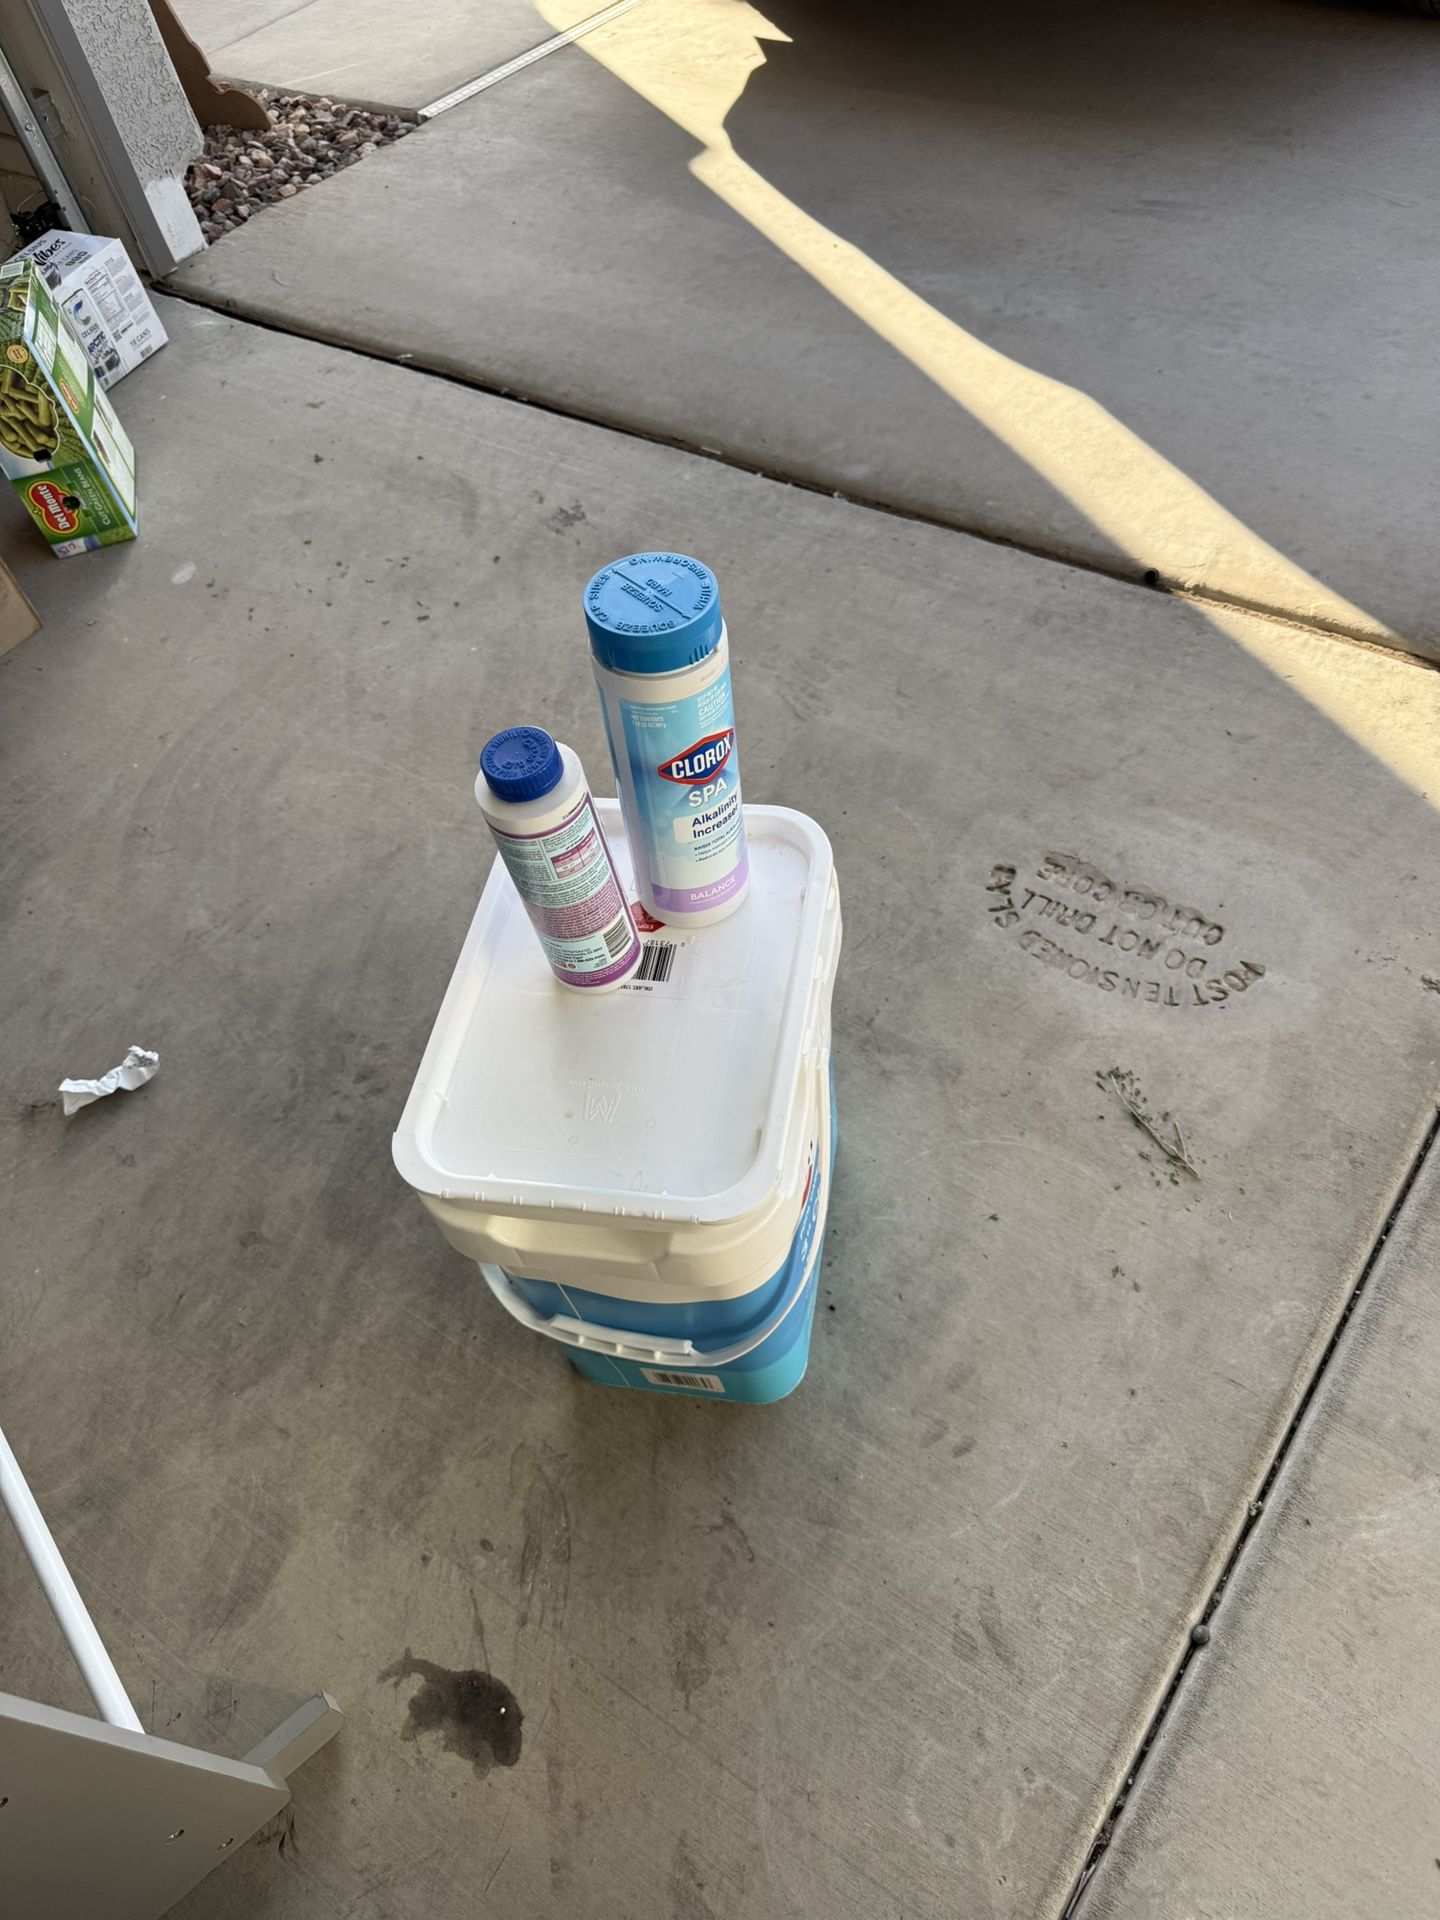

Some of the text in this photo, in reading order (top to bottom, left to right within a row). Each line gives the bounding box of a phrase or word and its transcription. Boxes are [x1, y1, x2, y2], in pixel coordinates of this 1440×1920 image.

[37, 484, 62, 514] Monte
[53, 512, 71, 530] Del
[620, 582, 664, 613] SQUEEZE
[645, 578, 673, 598] HARD
[693, 582, 712, 611] WHILE
[591, 604, 609, 623] CAP
[615, 620, 677, 634] SQUEEZE
[671, 732, 732, 780] CLOROX
[688, 777, 728, 808] SPA
[691, 790, 739, 828] Alkalinity
[692, 804, 740, 839] Increaser
[689, 873, 736, 902] BALANCE
[1020, 887, 1208, 979] DO NOT DRILL
[1160, 908, 1226, 946] CUT
[1016, 928, 1181, 1007] TENSIONED
[1190, 959, 1267, 1008] POST
